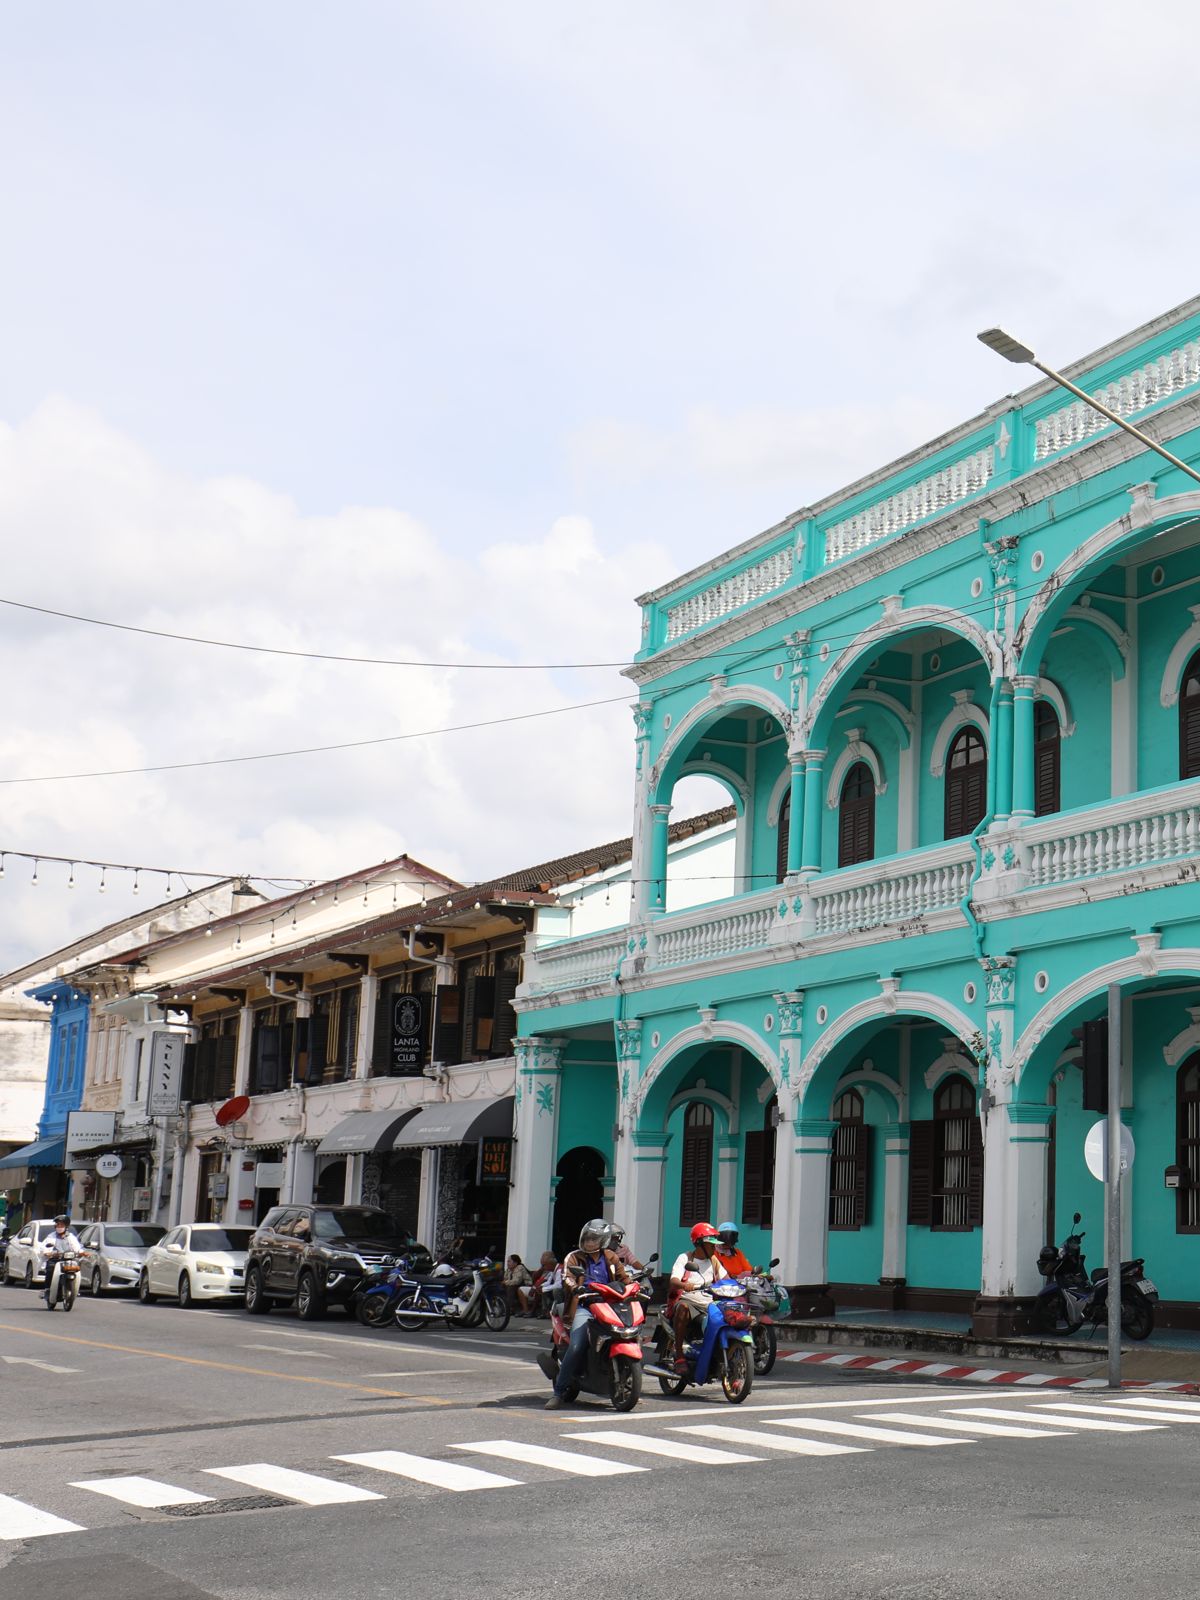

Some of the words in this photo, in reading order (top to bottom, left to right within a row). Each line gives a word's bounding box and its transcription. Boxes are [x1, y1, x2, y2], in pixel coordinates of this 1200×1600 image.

[394, 1037, 420, 1046] LANTA
[397, 1053, 416, 1062] CLUB
[161, 1043, 174, 1090] SUNNY
